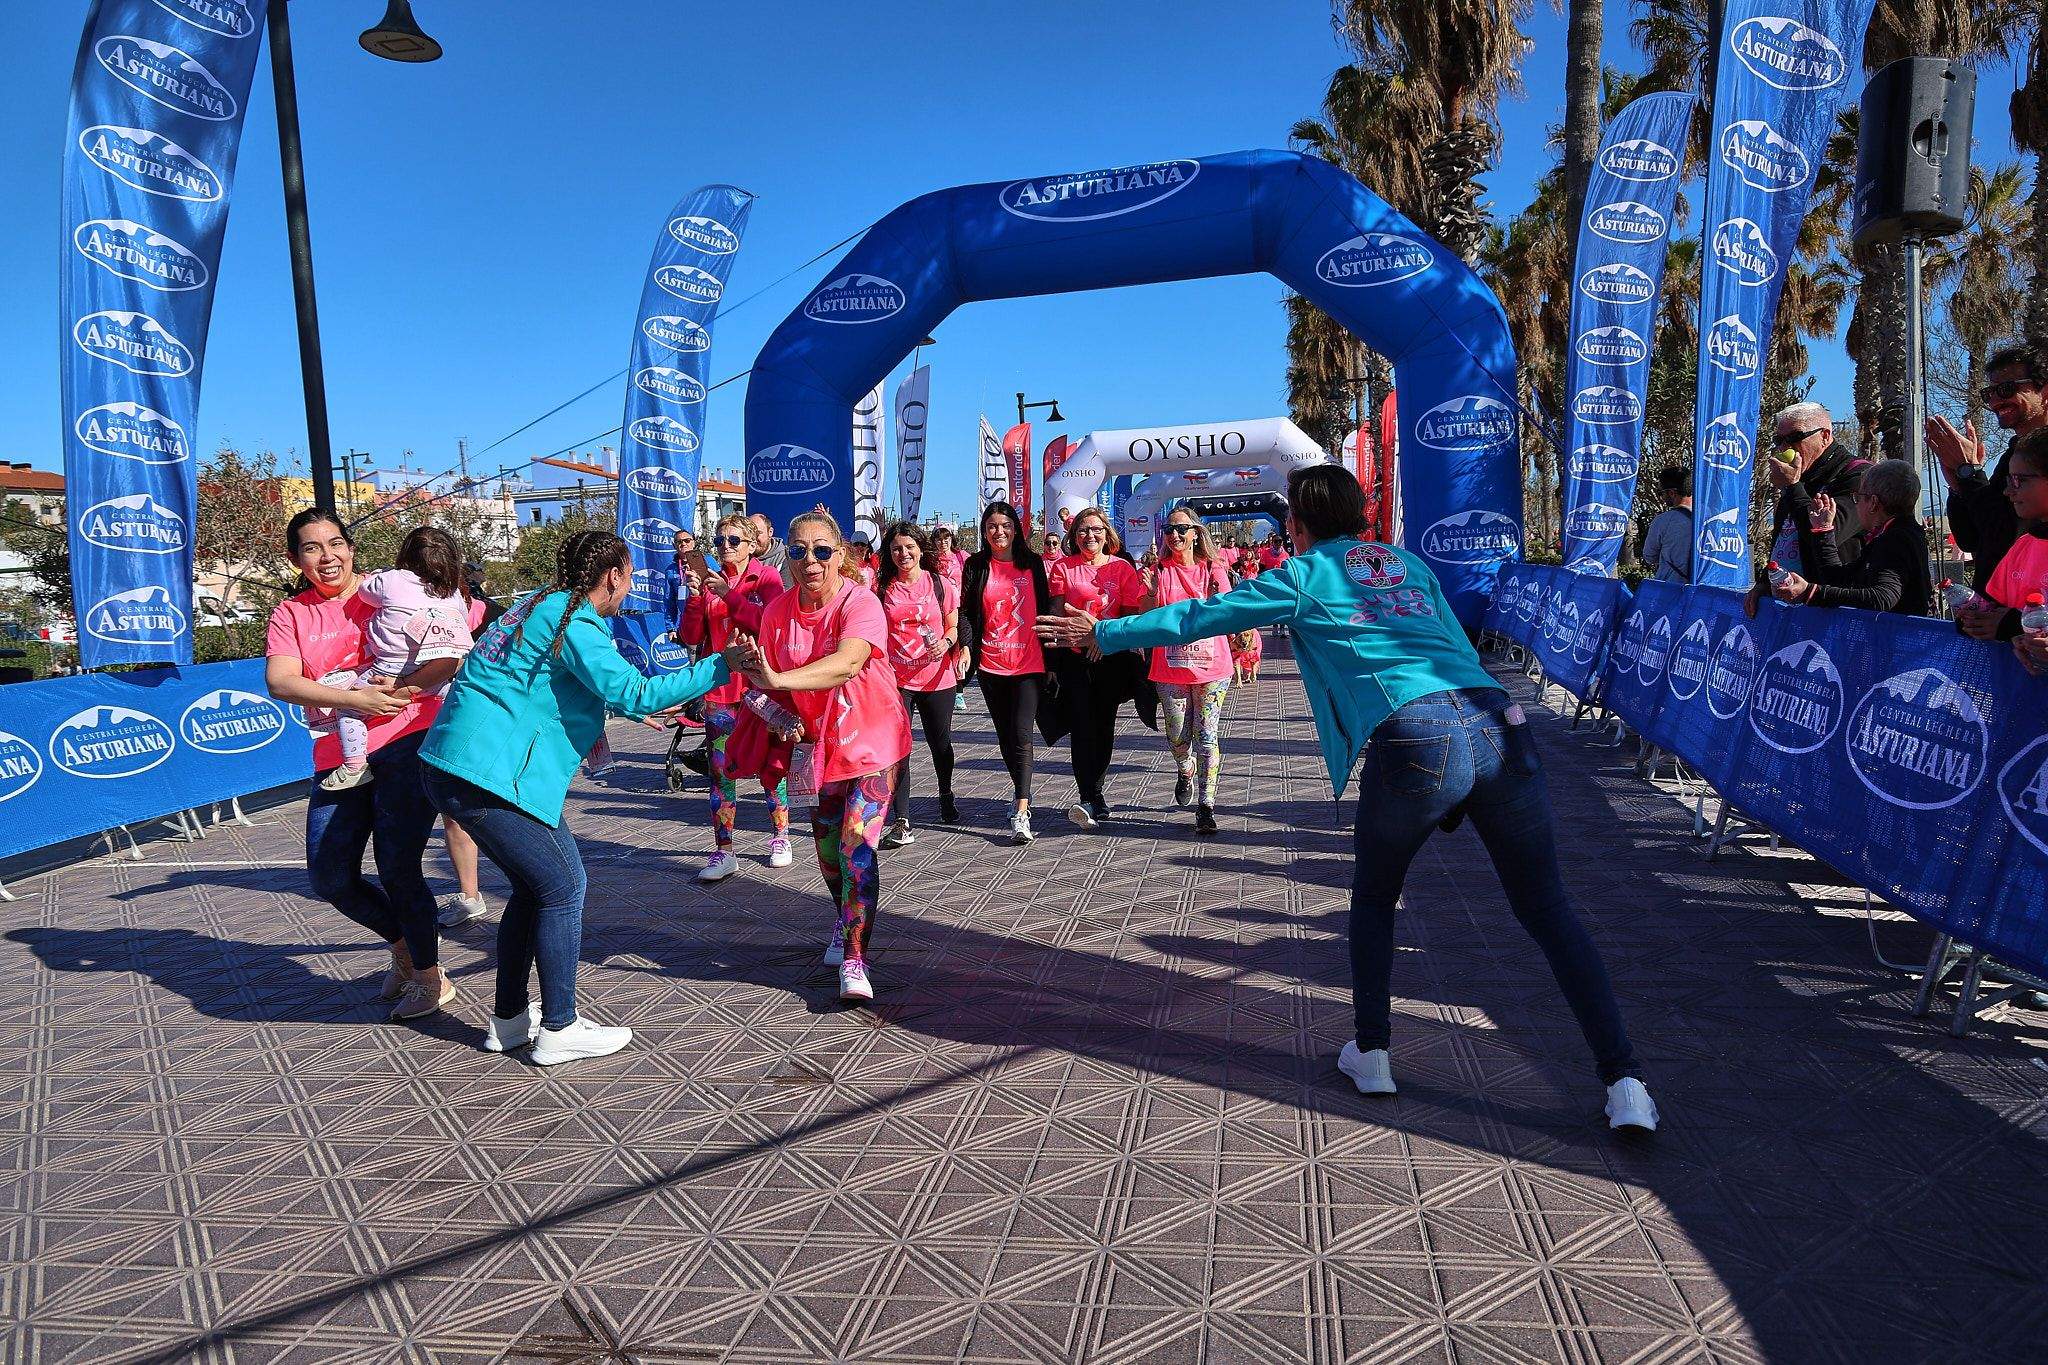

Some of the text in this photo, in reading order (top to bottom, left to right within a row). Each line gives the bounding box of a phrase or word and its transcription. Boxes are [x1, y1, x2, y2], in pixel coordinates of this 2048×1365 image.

[1757, 32, 1789, 52] CENTRAL
[1738, 28, 1833, 82] ASTURIANA
[105, 44, 225, 116] ASTURIANA
[132, 50, 223, 99] CENTRAL LECHERA
[90, 134, 212, 197] ASTURIANA
[113, 140, 210, 180] CENTRAL LECHERA
[1605, 151, 1670, 174] ASTURIANA
[1046, 161, 1178, 184] CENTRAL LECHERA
[1013, 166, 1185, 207] ASTURIANA
[674, 221, 732, 250] ASTURIANA
[1594, 213, 1660, 236] ASTURIANA
[84, 229, 197, 285] ASTURIANA
[148, 249, 194, 267] LECHERA
[1341, 246, 1420, 261] CENTRAL LECHERA
[1325, 253, 1427, 279] ASTURIANA
[659, 271, 719, 299] ASTURIANA
[1586, 275, 1649, 297] ASTURIANA
[809, 296, 897, 315] ASTURIANA
[648, 321, 706, 348] ASTURIANA
[83, 323, 183, 371] ASTURIANA
[1580, 338, 1641, 358] ASTURIANA
[640, 373, 700, 399] ASTURIANA
[1437, 414, 1474, 423] CENTRAL
[1576, 398, 1639, 417] ASTURIANA
[634, 424, 693, 450] ASTURIANA
[1422, 419, 1511, 440] ASTURIANA
[1128, 431, 1246, 463] OYSHO
[1280, 451, 1317, 463] OYSHO
[750, 464, 828, 483] ASTURIANA
[984, 435, 1006, 501] SHO
[1013, 441, 1024, 503] Santander
[1061, 469, 1096, 478] OYSHO
[1572, 456, 1632, 474] ASTURIANA
[631, 475, 687, 497] ASTURIANA
[1203, 500, 1261, 509] VOLVO
[628, 526, 675, 546] ASTURIAN
[1443, 528, 1480, 536] CENTRAL
[1567, 518, 1625, 532] ASTURIANA
[1428, 532, 1517, 553] ASTURIANA
[1772, 671, 1802, 690] CENTRAL
[201, 704, 271, 722] CENTRAL LECHERA
[1753, 671, 1830, 735] ASTURIANA
[76, 723, 158, 743] CENTRAL LECHERA
[191, 712, 280, 743] ASTURIANA
[1879, 705, 1976, 745] CENTRAL LECHERA
[63, 732, 169, 767] ASTURIANA
[1851, 704, 1972, 789] ASTURIANA
